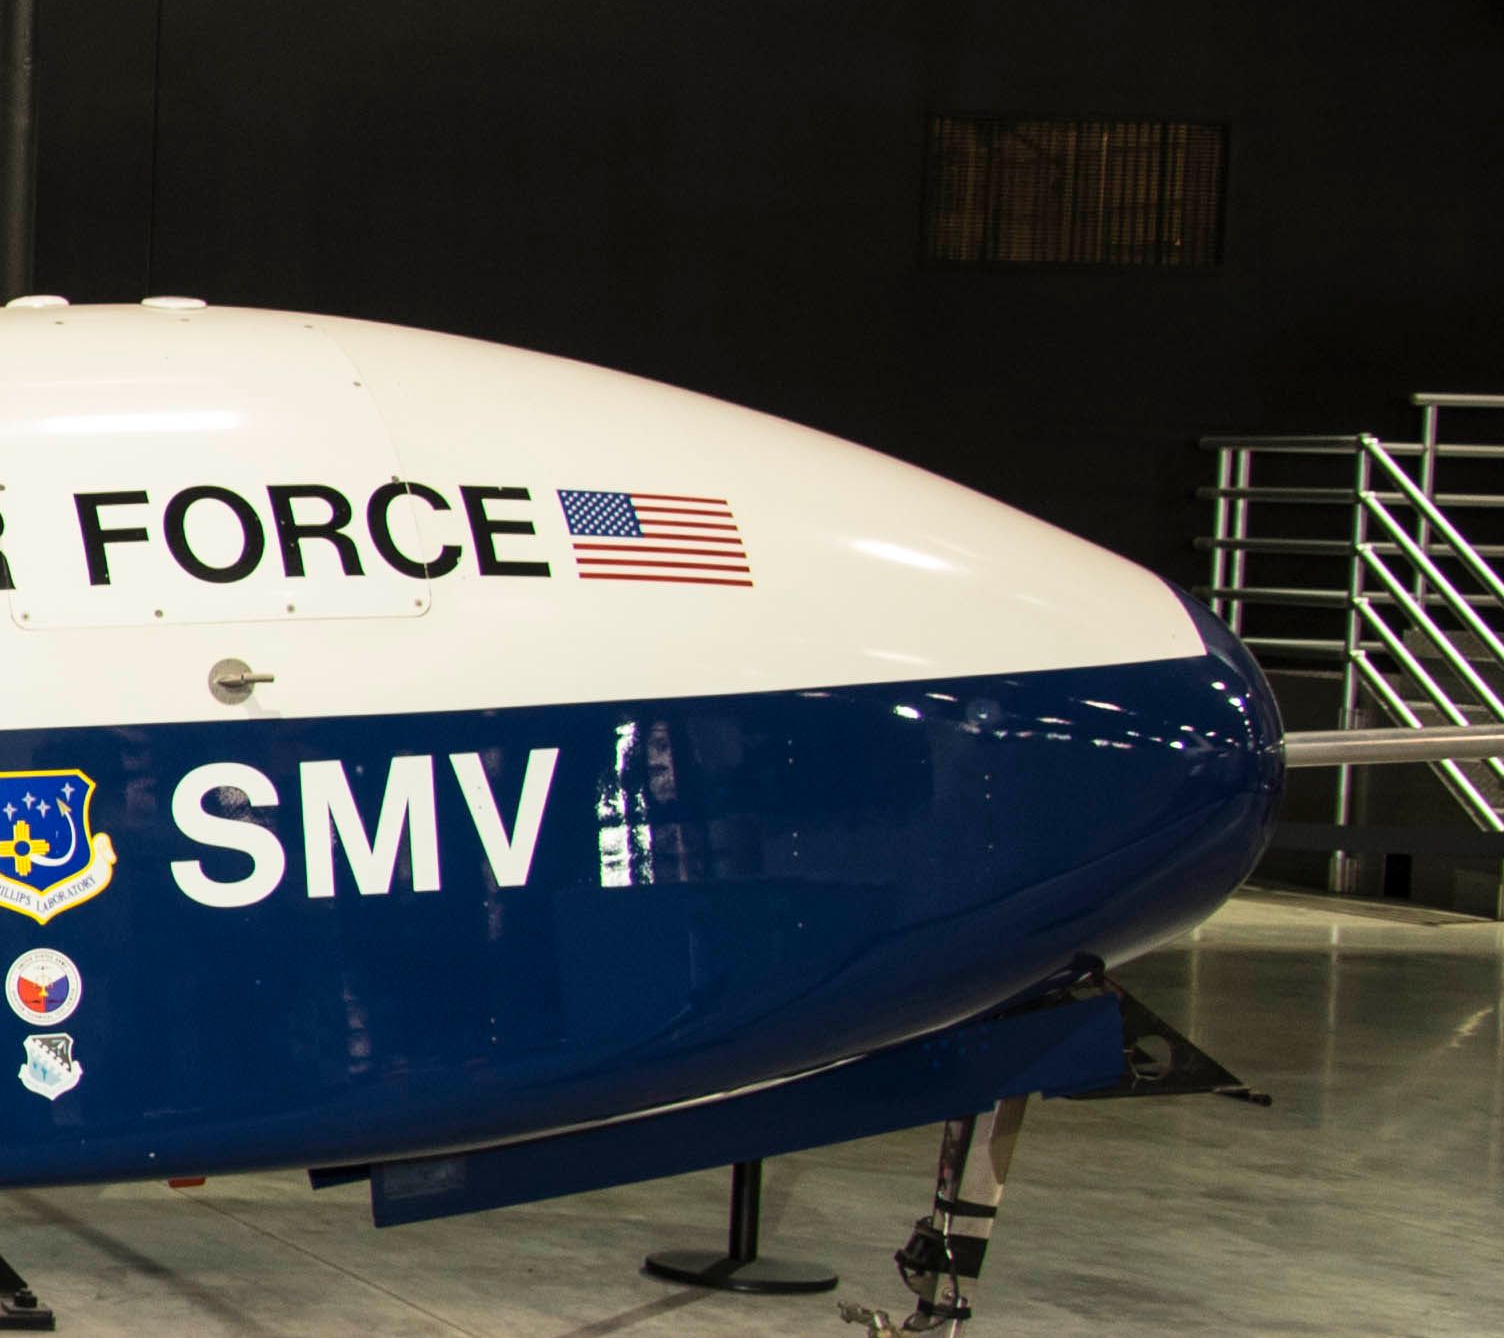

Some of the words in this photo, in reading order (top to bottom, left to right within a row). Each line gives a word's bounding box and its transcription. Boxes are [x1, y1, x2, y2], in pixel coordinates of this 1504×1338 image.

[74, 482, 551, 584] FORCE
[170, 748, 559, 908] SMV
[36, 875, 97, 913] LABORATORY
